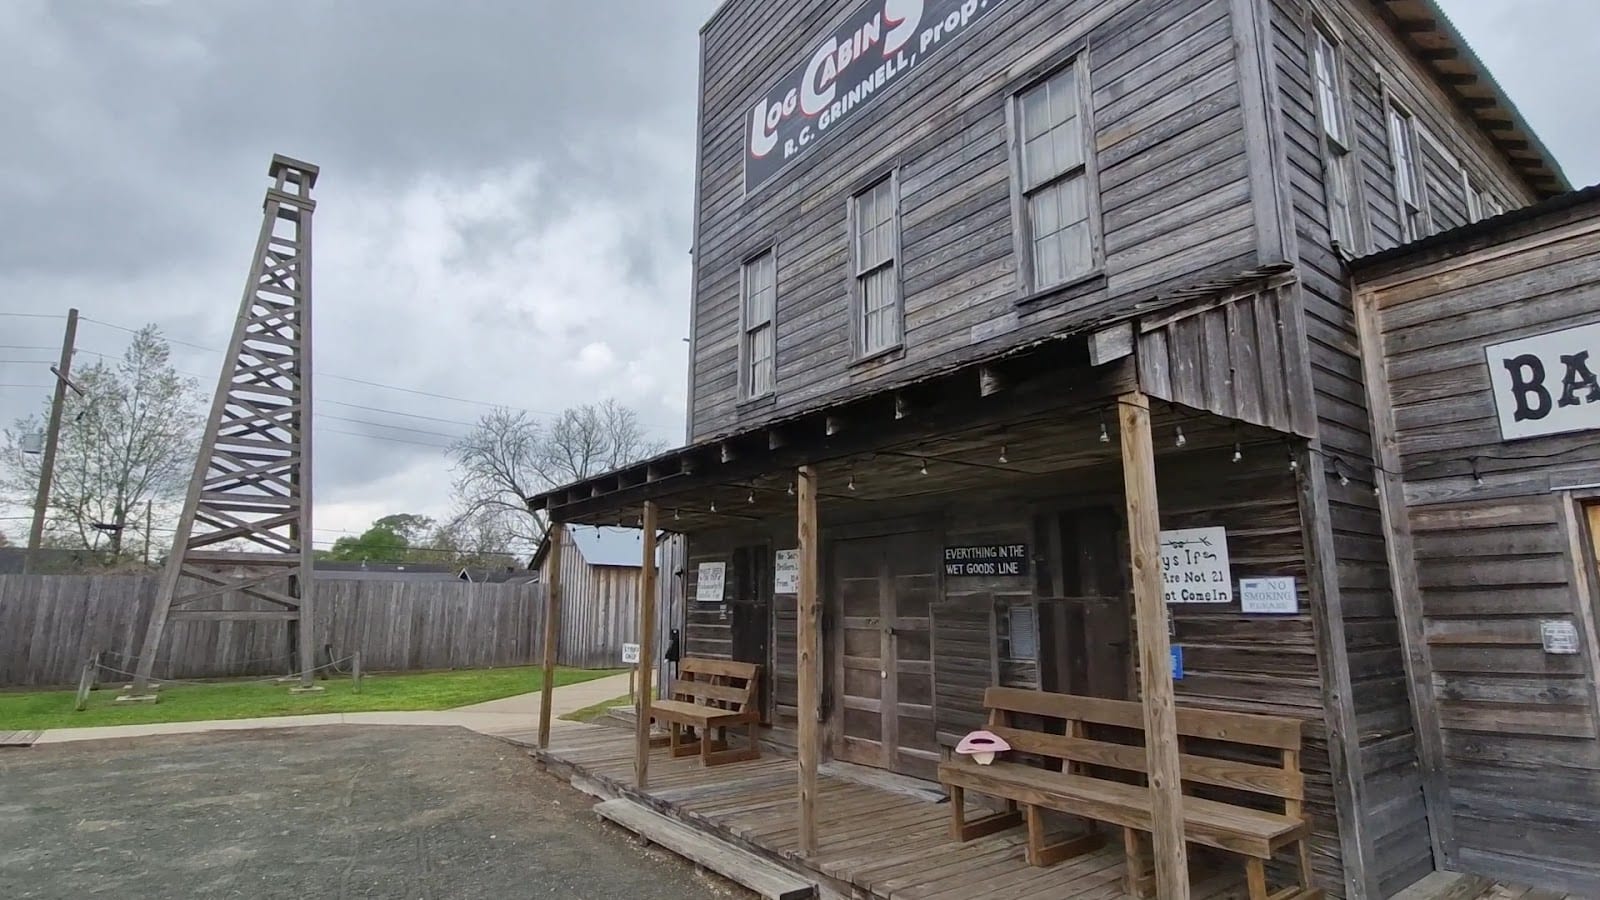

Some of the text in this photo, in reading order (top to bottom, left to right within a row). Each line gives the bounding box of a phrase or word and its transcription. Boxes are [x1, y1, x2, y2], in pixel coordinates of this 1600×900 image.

[751, 87, 797, 158] LOG
[800, 12, 881, 116] CABIN
[818, 52, 917, 130] GRINNELL,
[945, 546, 998, 560] EVERYTHING
[946, 562, 1020, 575] WET GOODS LINE
[1162, 556, 1180, 571] ys
[1184, 571, 1206, 583] Not
[1211, 570, 1224, 583] 21
[1269, 580, 1287, 590] NO
[1165, 591, 1177, 601] ot
[1243, 591, 1293, 601] SMOKING
